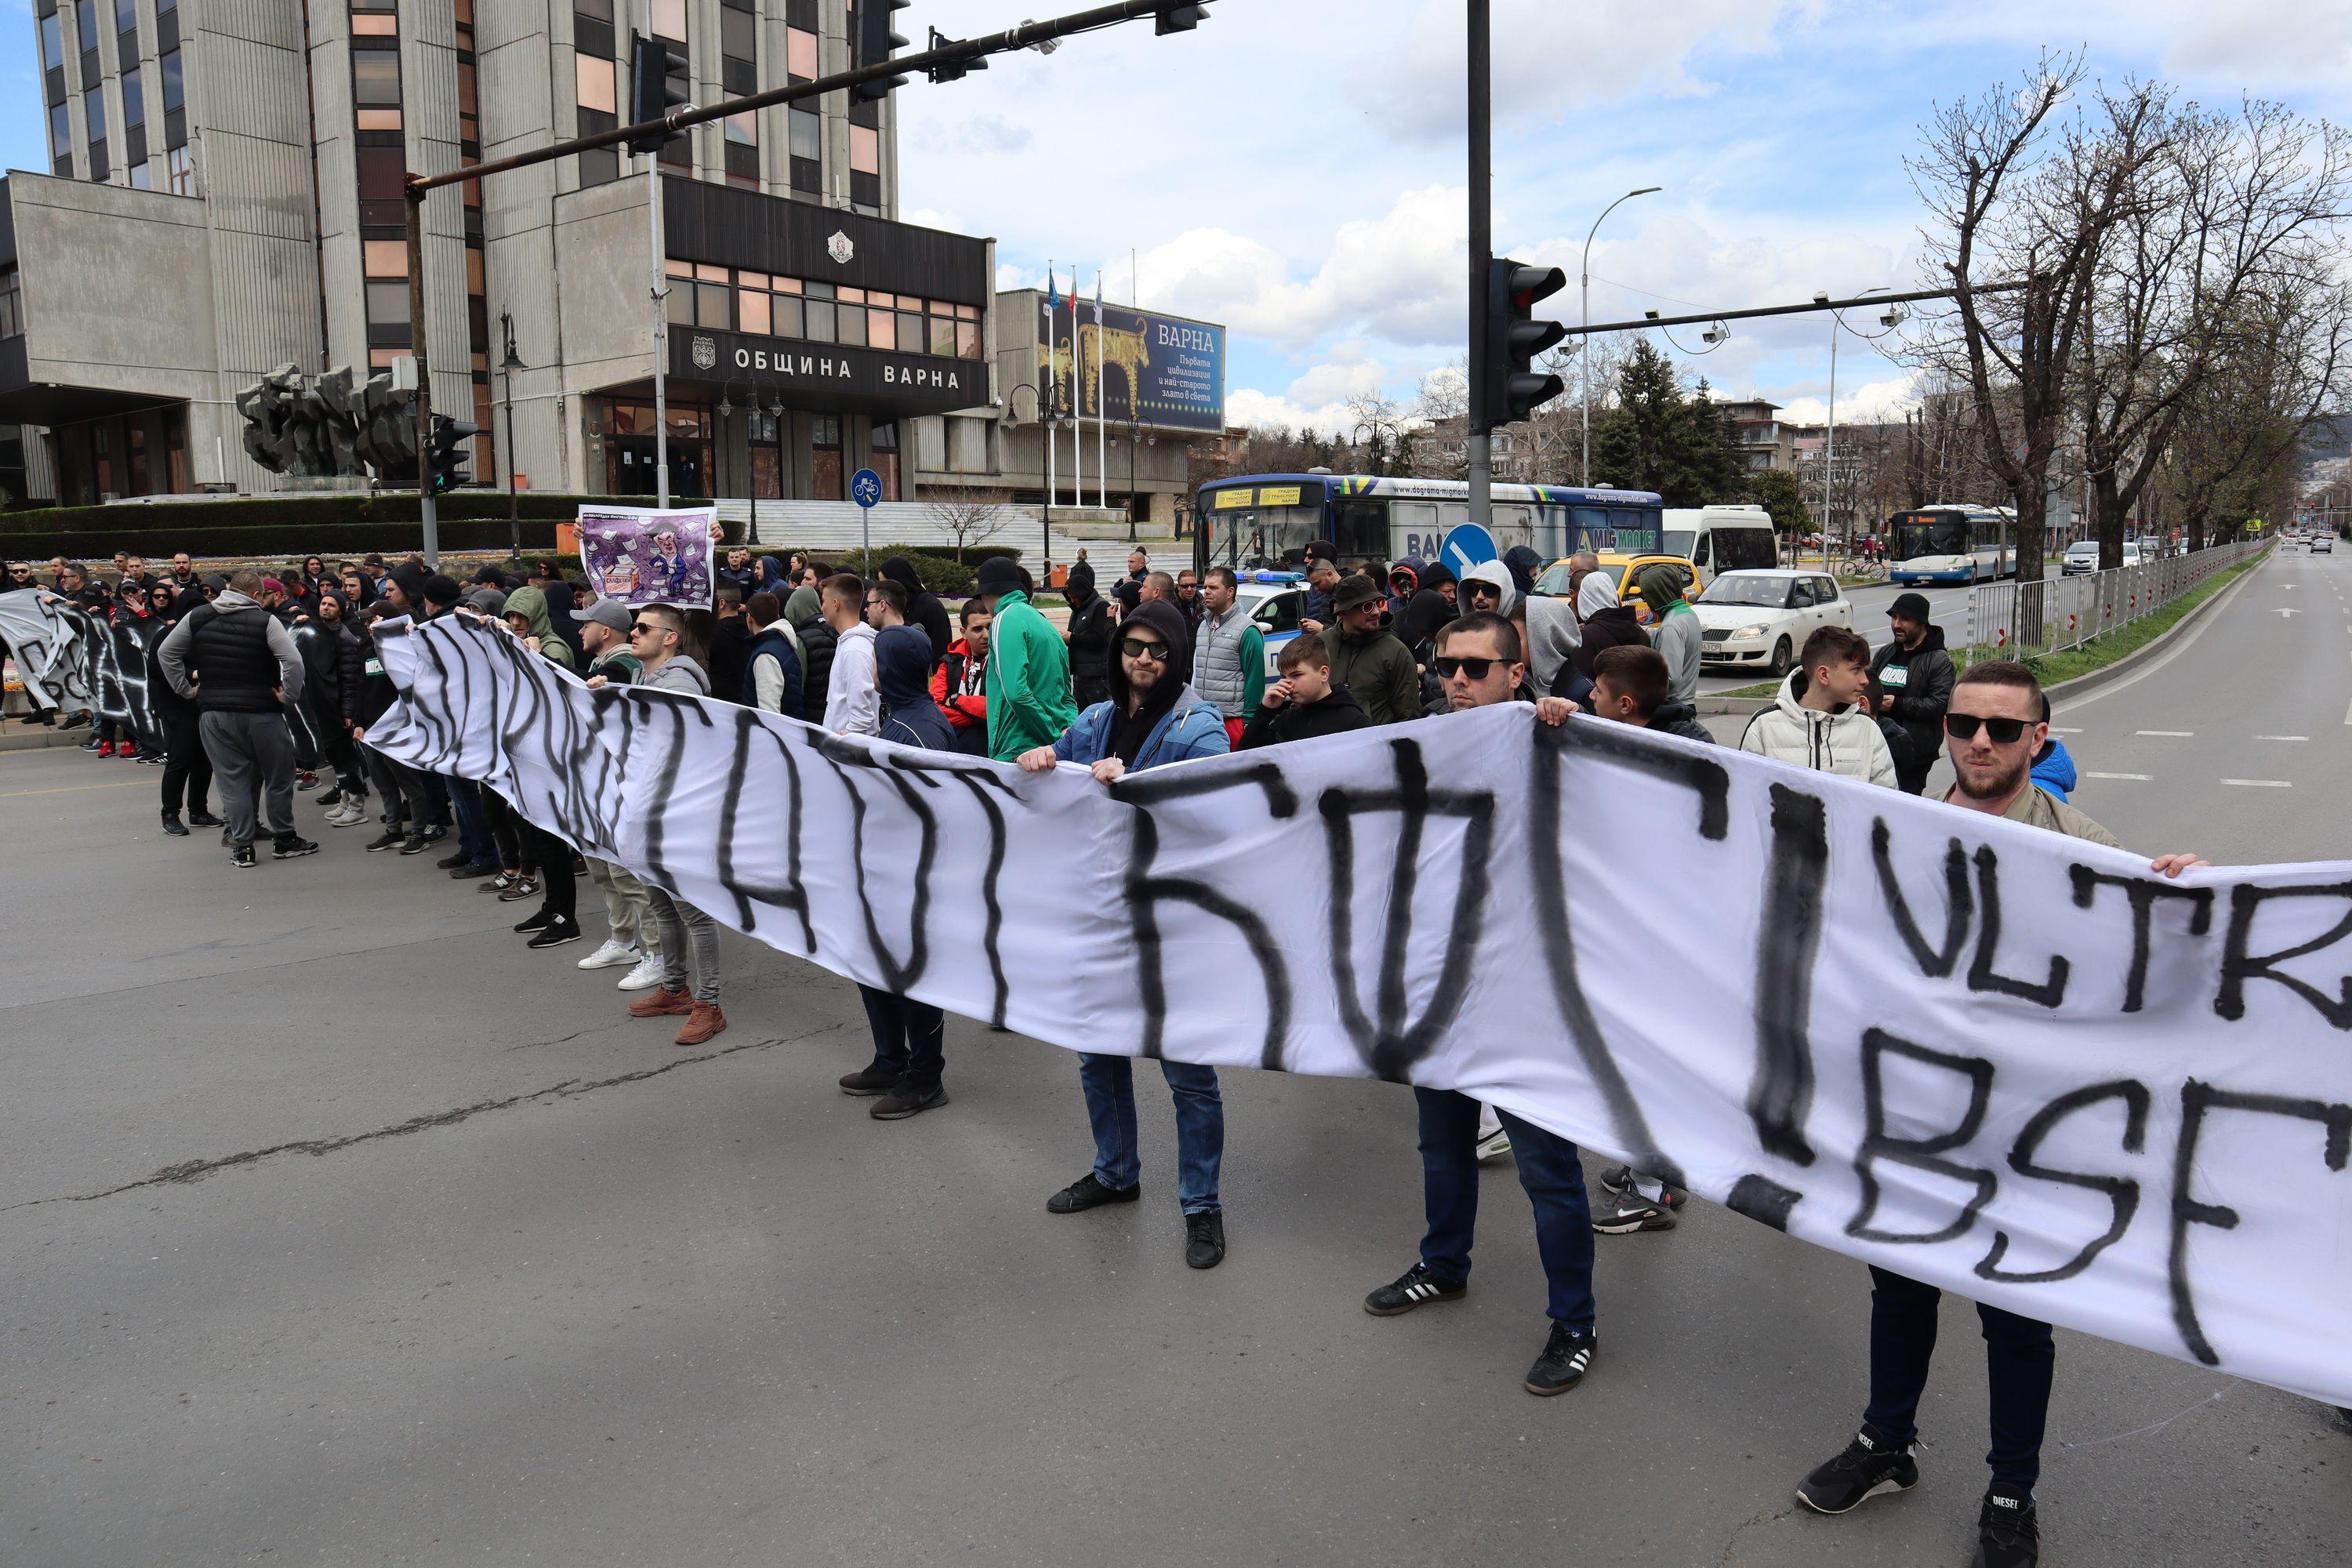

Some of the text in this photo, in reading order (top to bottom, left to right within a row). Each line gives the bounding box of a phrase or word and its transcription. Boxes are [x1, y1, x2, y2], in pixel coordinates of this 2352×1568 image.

[1158, 324, 1215, 353] ВАРНА
[735, 348, 959, 389] ОБЩИНА ВАРНА
[1179, 354, 1210, 368] Първата
[1167, 365, 1210, 379] цивилизация
[1164, 376, 1210, 391] най-старото
[1162, 390, 1184, 398] злато
[1190, 392, 1210, 402] света
[1593, 528, 1657, 550] MIG MARKET
[1846, 1027, 2352, 1366] BSF
[1992, 1495, 2018, 1509] DIESEL
